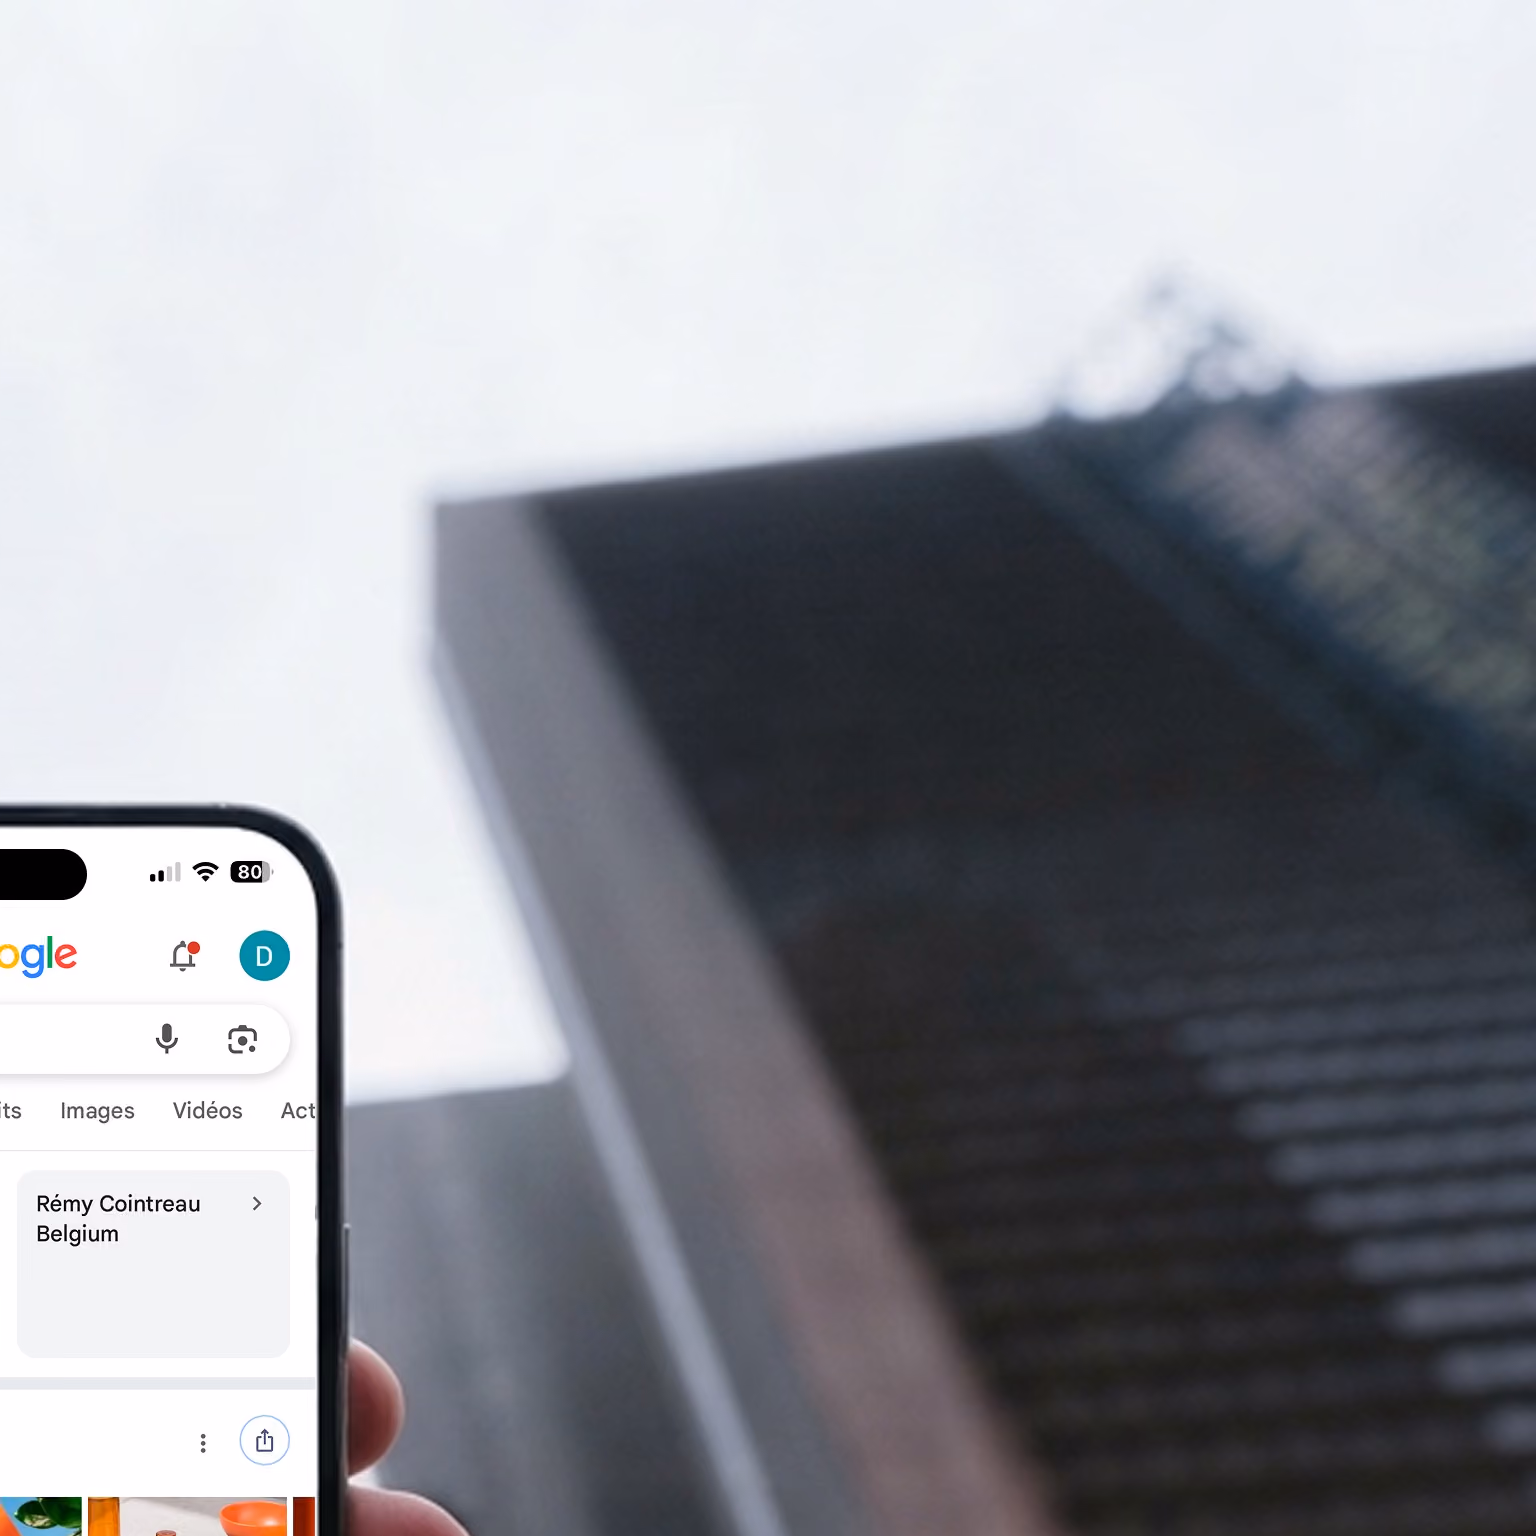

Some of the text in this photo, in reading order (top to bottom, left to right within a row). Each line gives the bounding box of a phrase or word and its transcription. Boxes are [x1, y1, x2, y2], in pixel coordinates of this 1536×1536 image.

[238, 864, 262, 880] 80
[256, 945, 273, 967] D
[61, 1101, 135, 1124] Images
[172, 1100, 243, 1120] Vidéos
[281, 1101, 316, 1120] Act
[37, 1193, 201, 1217] Rémy Cointreau
[37, 1223, 119, 1247] Belgium
